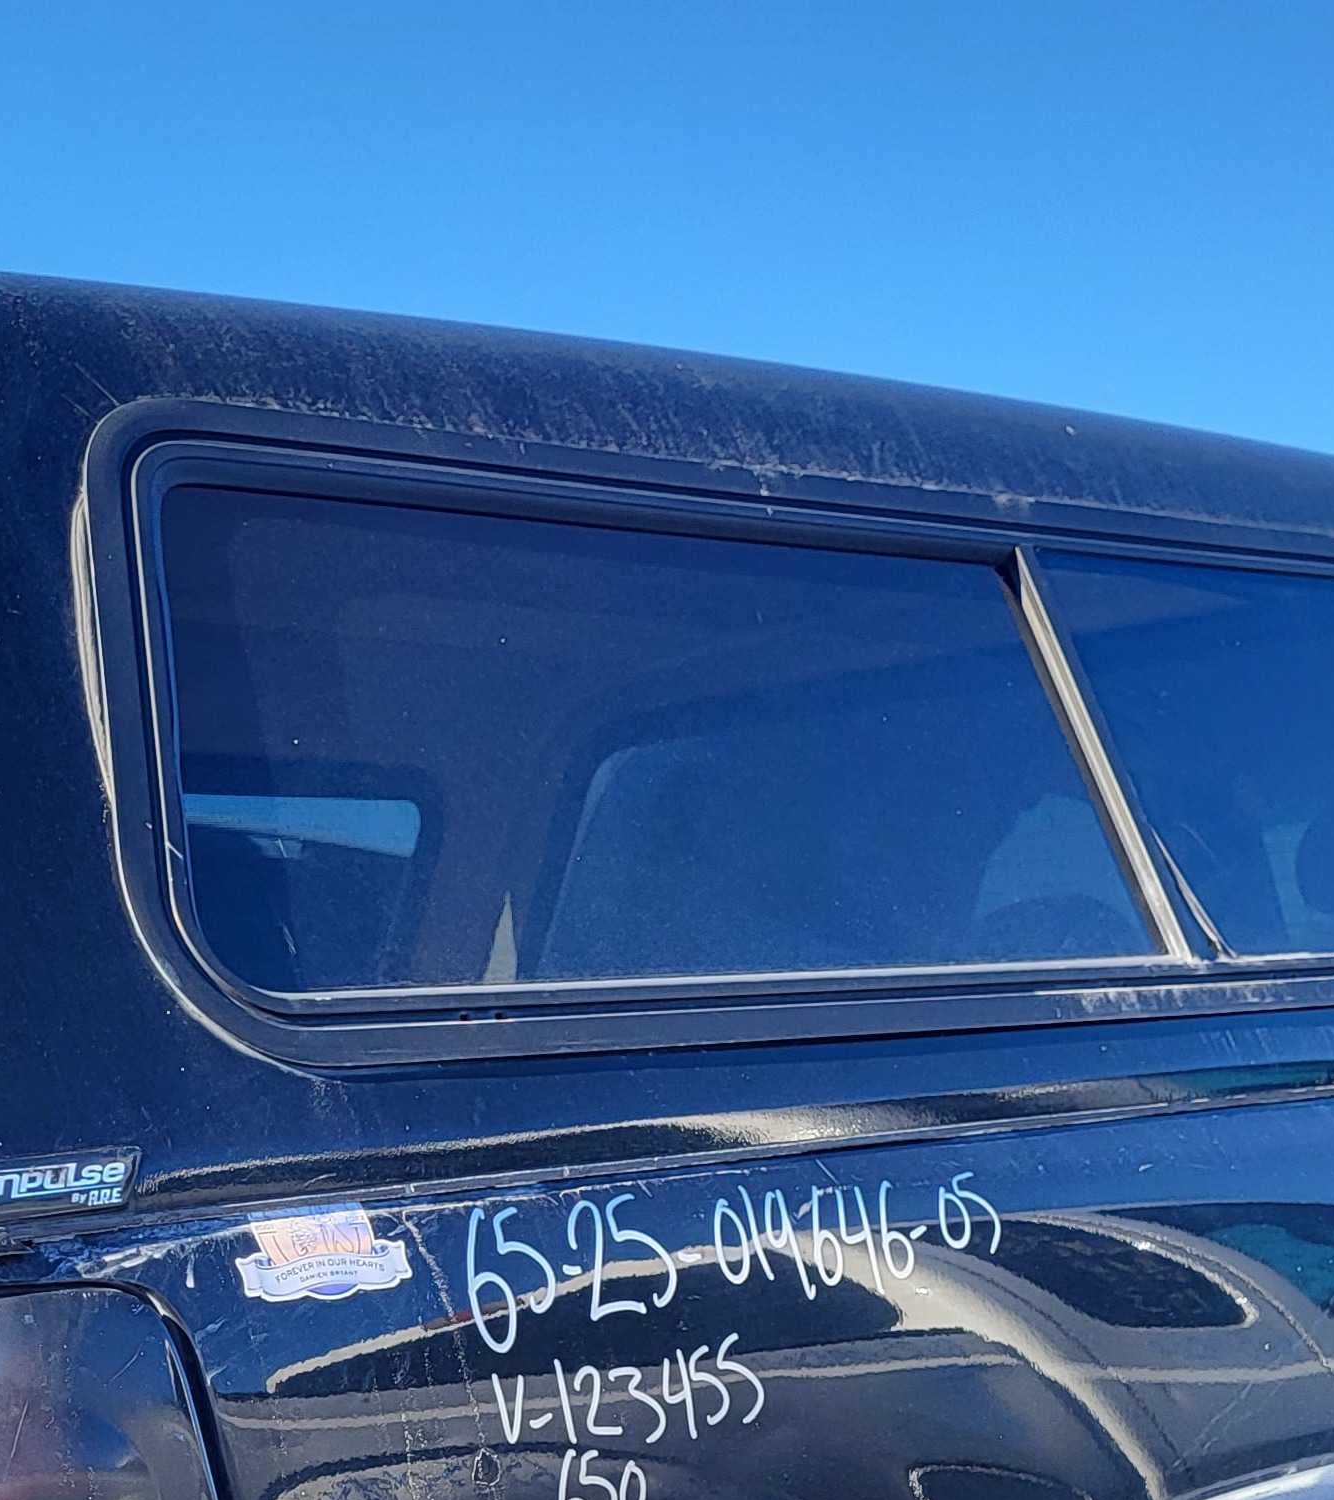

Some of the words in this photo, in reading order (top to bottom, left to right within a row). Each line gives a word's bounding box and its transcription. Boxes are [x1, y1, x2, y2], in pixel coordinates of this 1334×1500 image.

[275, 1261, 315, 1283] FOREVER
[315, 1259, 326, 1268] IN
[327, 1258, 348, 1268] OUR
[349, 1259, 385, 1272] HEARTS
[467, 1173, 1002, 1353] 65-25-019646-05
